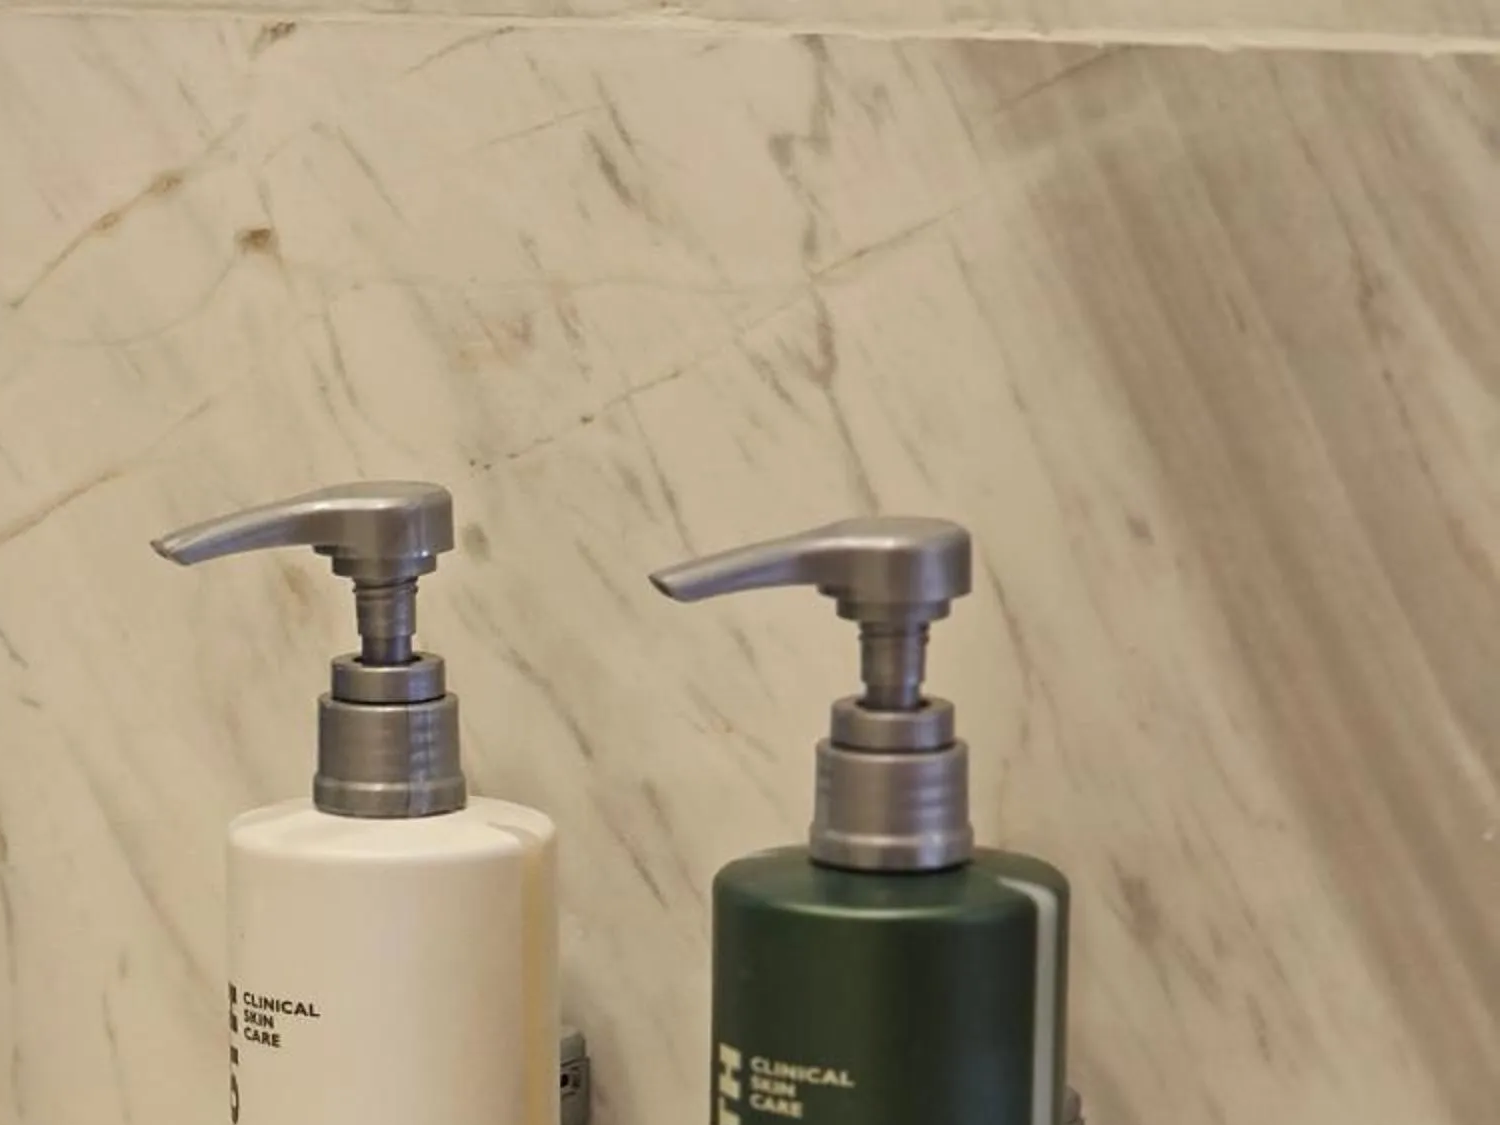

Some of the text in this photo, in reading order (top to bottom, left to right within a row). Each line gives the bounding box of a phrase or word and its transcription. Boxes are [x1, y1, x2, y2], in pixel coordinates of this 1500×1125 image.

[243, 992, 321, 1018] CLINICAL
[243, 1009, 275, 1029] SKIN
[244, 1027, 281, 1048] CARE
[750, 1056, 855, 1088] CLINICAL
[750, 1075, 797, 1098] SKIN
[749, 1094, 803, 1119] CARE
